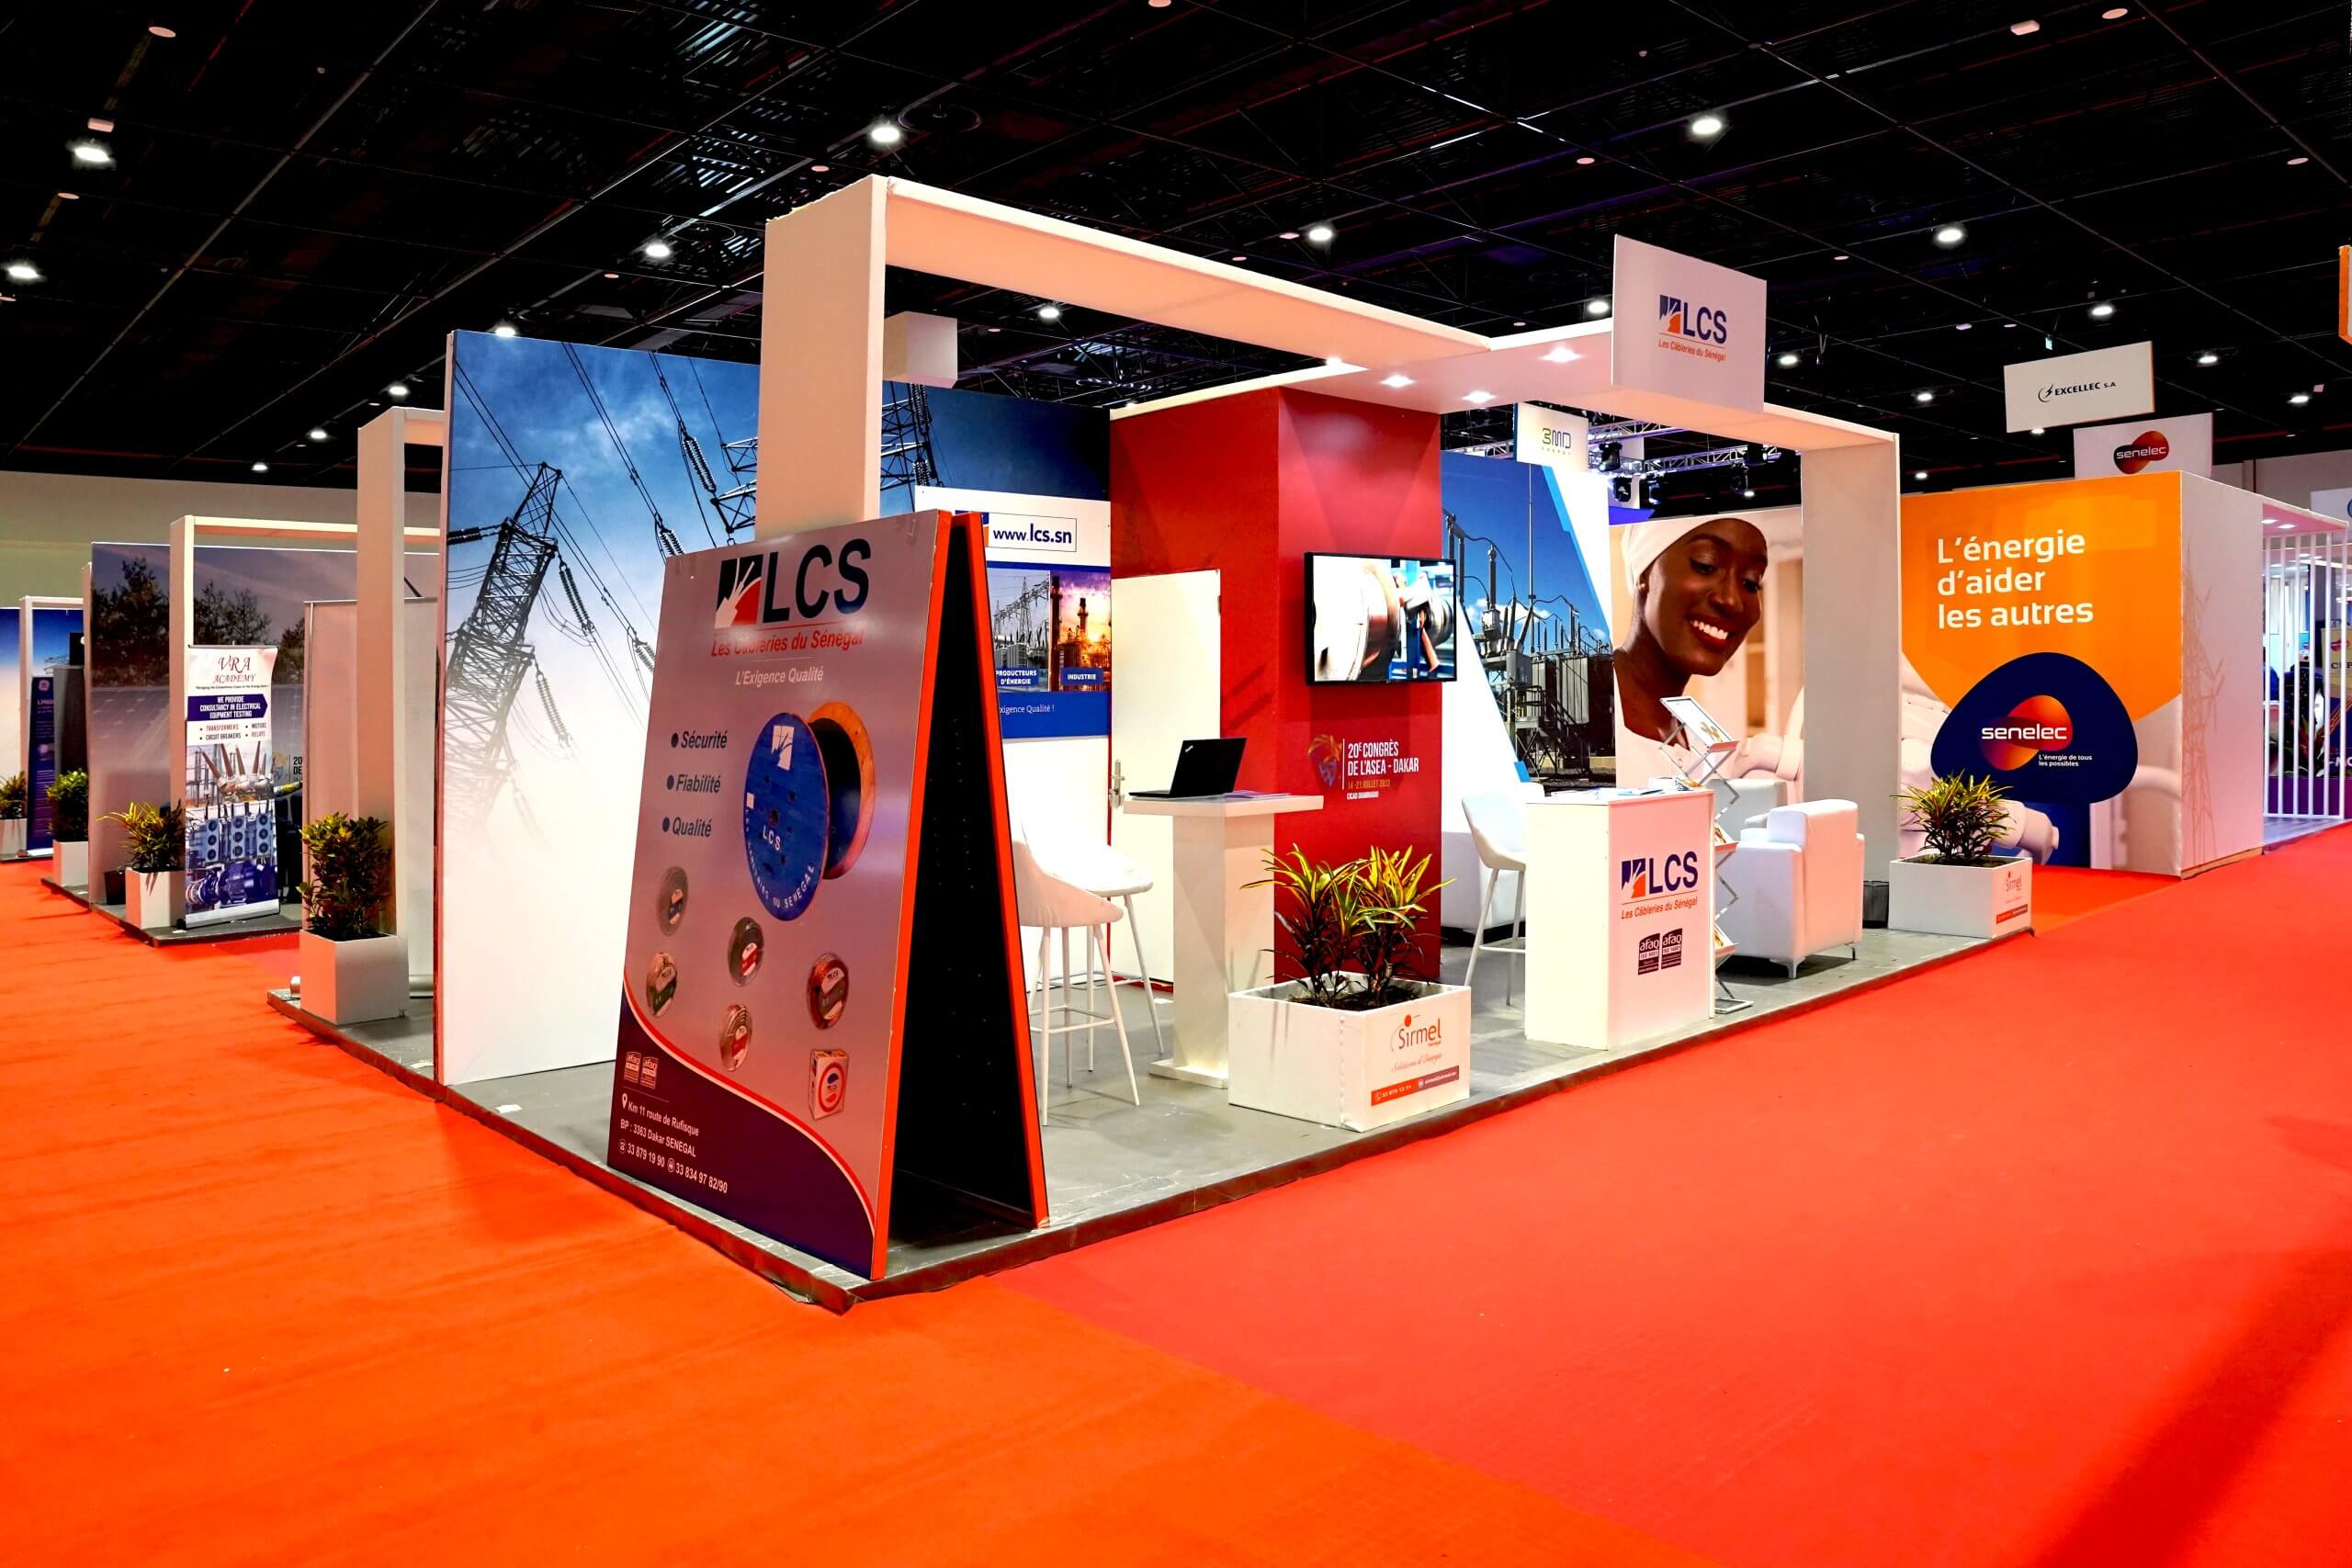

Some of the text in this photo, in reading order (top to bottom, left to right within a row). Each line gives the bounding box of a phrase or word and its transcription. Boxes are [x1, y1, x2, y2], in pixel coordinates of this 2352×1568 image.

[1683, 302, 1727, 344] LCS
[1658, 338, 1669, 349] Les
[1696, 348, 1704, 356] du
[2054, 382, 2101, 396] EXCELLEC
[2116, 446, 2166, 459] senelec
[992, 523, 1072, 544] www.lcs.sn
[1938, 529, 2086, 564] L'énergie
[763, 538, 872, 624] LCS
[1938, 567, 2045, 597] d'aider
[1938, 601, 2094, 629] les autres
[711, 640, 731, 657] Les
[791, 632, 807, 651] du
[218, 655, 251, 673] VRA
[213, 673, 256, 684] ACADEMY
[736, 665, 824, 687] L'Exigence Qualité
[1001, 677, 1031, 685] D'ÉNERGIE
[200, 704, 229, 712] CONSULTANCY
[999, 705, 1025, 715] xigence
[1026, 705, 1051, 714] Qualité
[680, 730, 728, 750] Sécurité
[1981, 723, 2067, 739] senelec
[1363, 739, 1399, 758] CONGRÈS
[2039, 753, 2067, 761] L'énergie
[1347, 761, 1359, 776] DE
[1360, 759, 1386, 775] L'ASEA
[1393, 757, 1419, 773] DAKAR
[675, 773, 721, 794] Fiabilité
[673, 817, 712, 838] Qualité
[1649, 851, 1698, 895] LCS
[1621, 897, 1698, 919] Les Câbleries du Sénégal
[1398, 1017, 1441, 1049] Sirmel
[628, 1101, 699, 1136] Km 11 route de Rufisque
[620, 1119, 629, 1129] BP
[647, 1129, 665, 1145] Dakar
[665, 1136, 696, 1157] SENEGAL
[628, 1143, 728, 1194] 33 879 19 90 33 834 97 82/90
